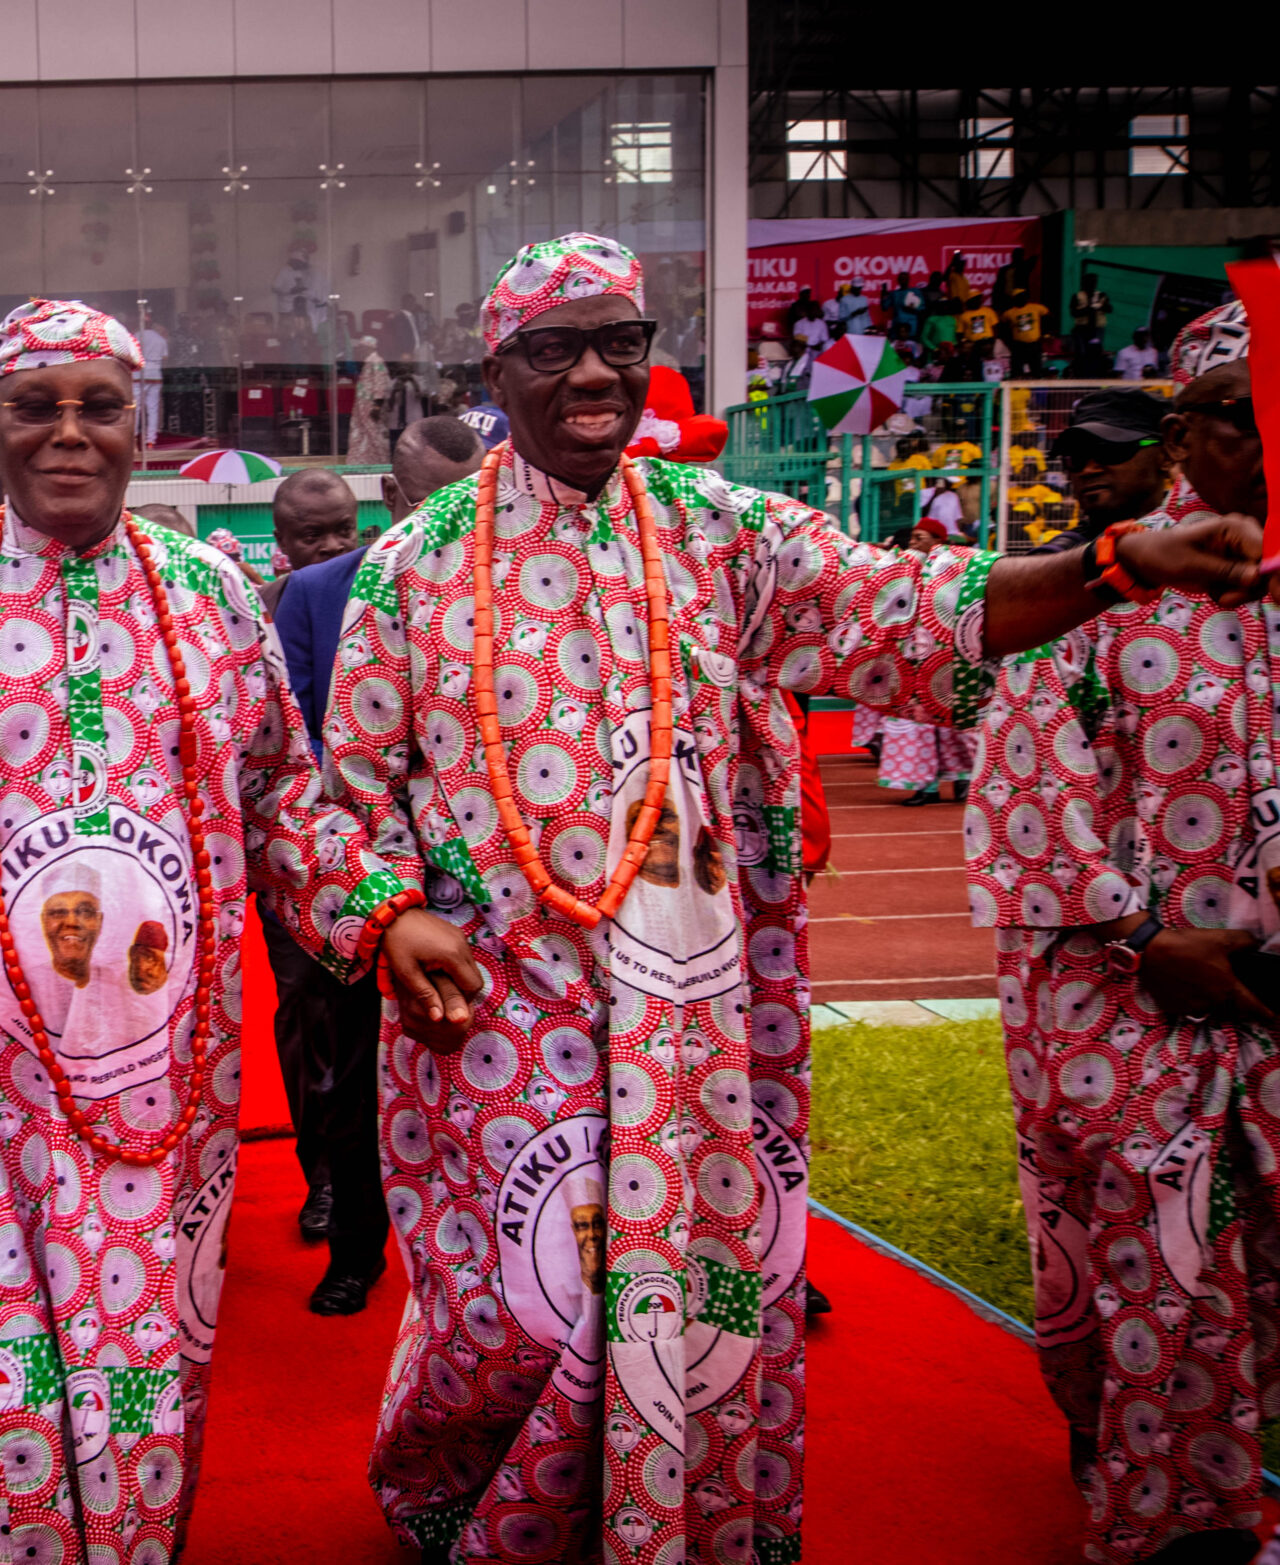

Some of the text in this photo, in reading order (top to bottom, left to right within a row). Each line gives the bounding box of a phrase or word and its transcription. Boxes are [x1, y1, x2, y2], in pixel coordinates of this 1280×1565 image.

[746, 257, 798, 278] TIKU
[833, 255, 929, 276] OKOWA
[960, 252, 1012, 269] TIKU
[113, 817, 193, 946] OKOWA
[502, 1134, 571, 1247] ATIKU
[653, 1400, 674, 1422] JOIN
